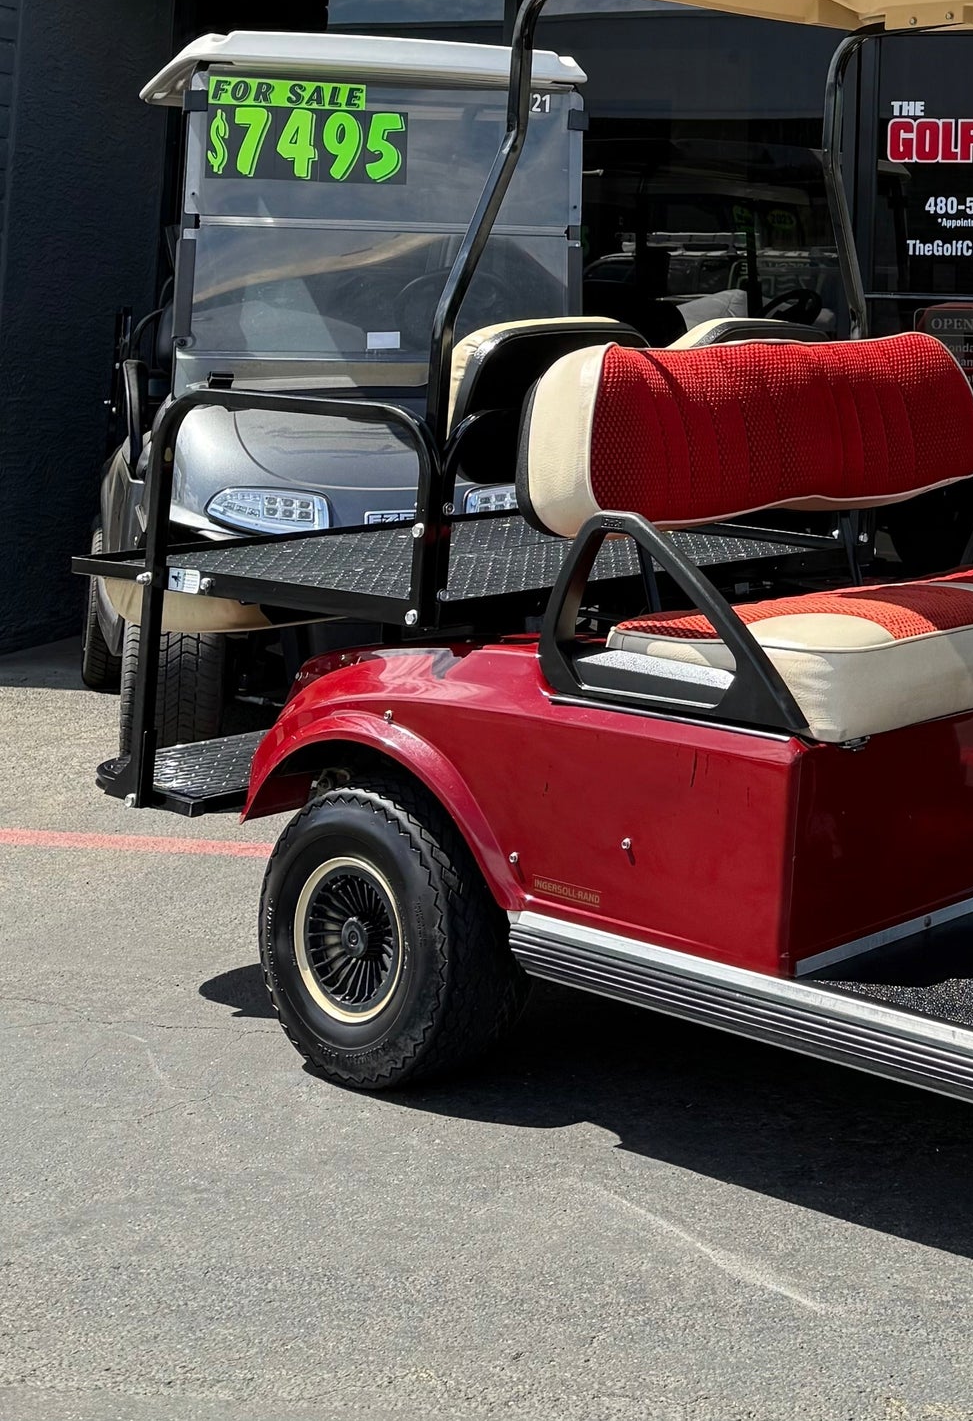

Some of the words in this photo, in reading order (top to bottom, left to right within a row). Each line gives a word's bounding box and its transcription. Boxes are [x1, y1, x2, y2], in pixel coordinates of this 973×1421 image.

[211, 79, 275, 104] FOR
[286, 83, 363, 108] SALE
[891, 101, 925, 116] THE
[207, 106, 406, 183] $7495
[534, 878, 600, 904] INGERSOLL-RAND
